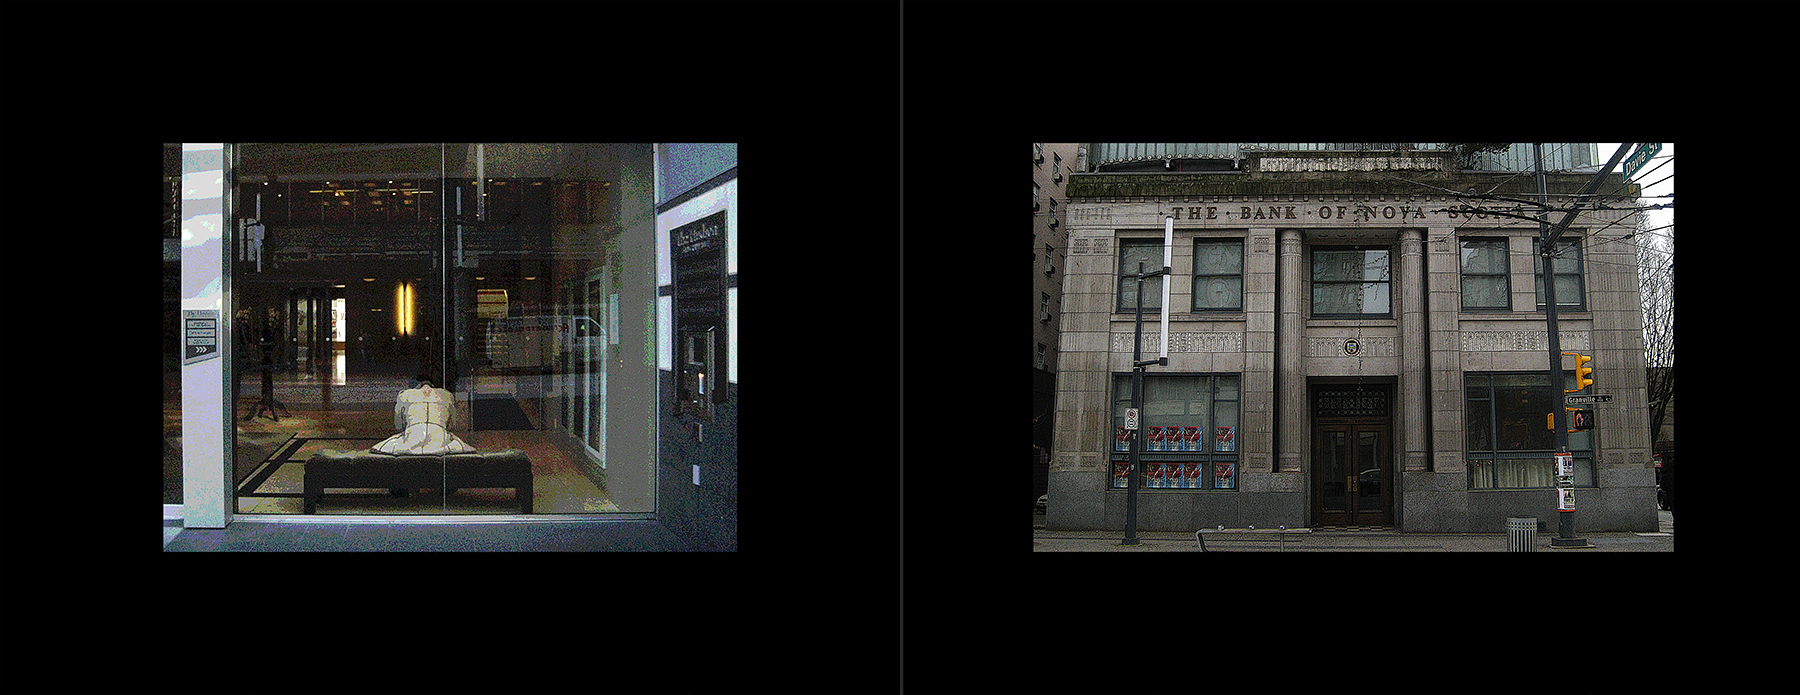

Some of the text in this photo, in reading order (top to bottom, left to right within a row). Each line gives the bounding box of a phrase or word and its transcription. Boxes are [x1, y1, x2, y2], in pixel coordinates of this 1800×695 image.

[1625, 150, 1646, 176] Davie
[1172, 206, 1218, 219] THE
[1240, 206, 1298, 219] BANK
[1318, 206, 1347, 219] OF
[1365, 205, 1426, 219] NOVA
[1568, 396, 1596, 404] Granville
